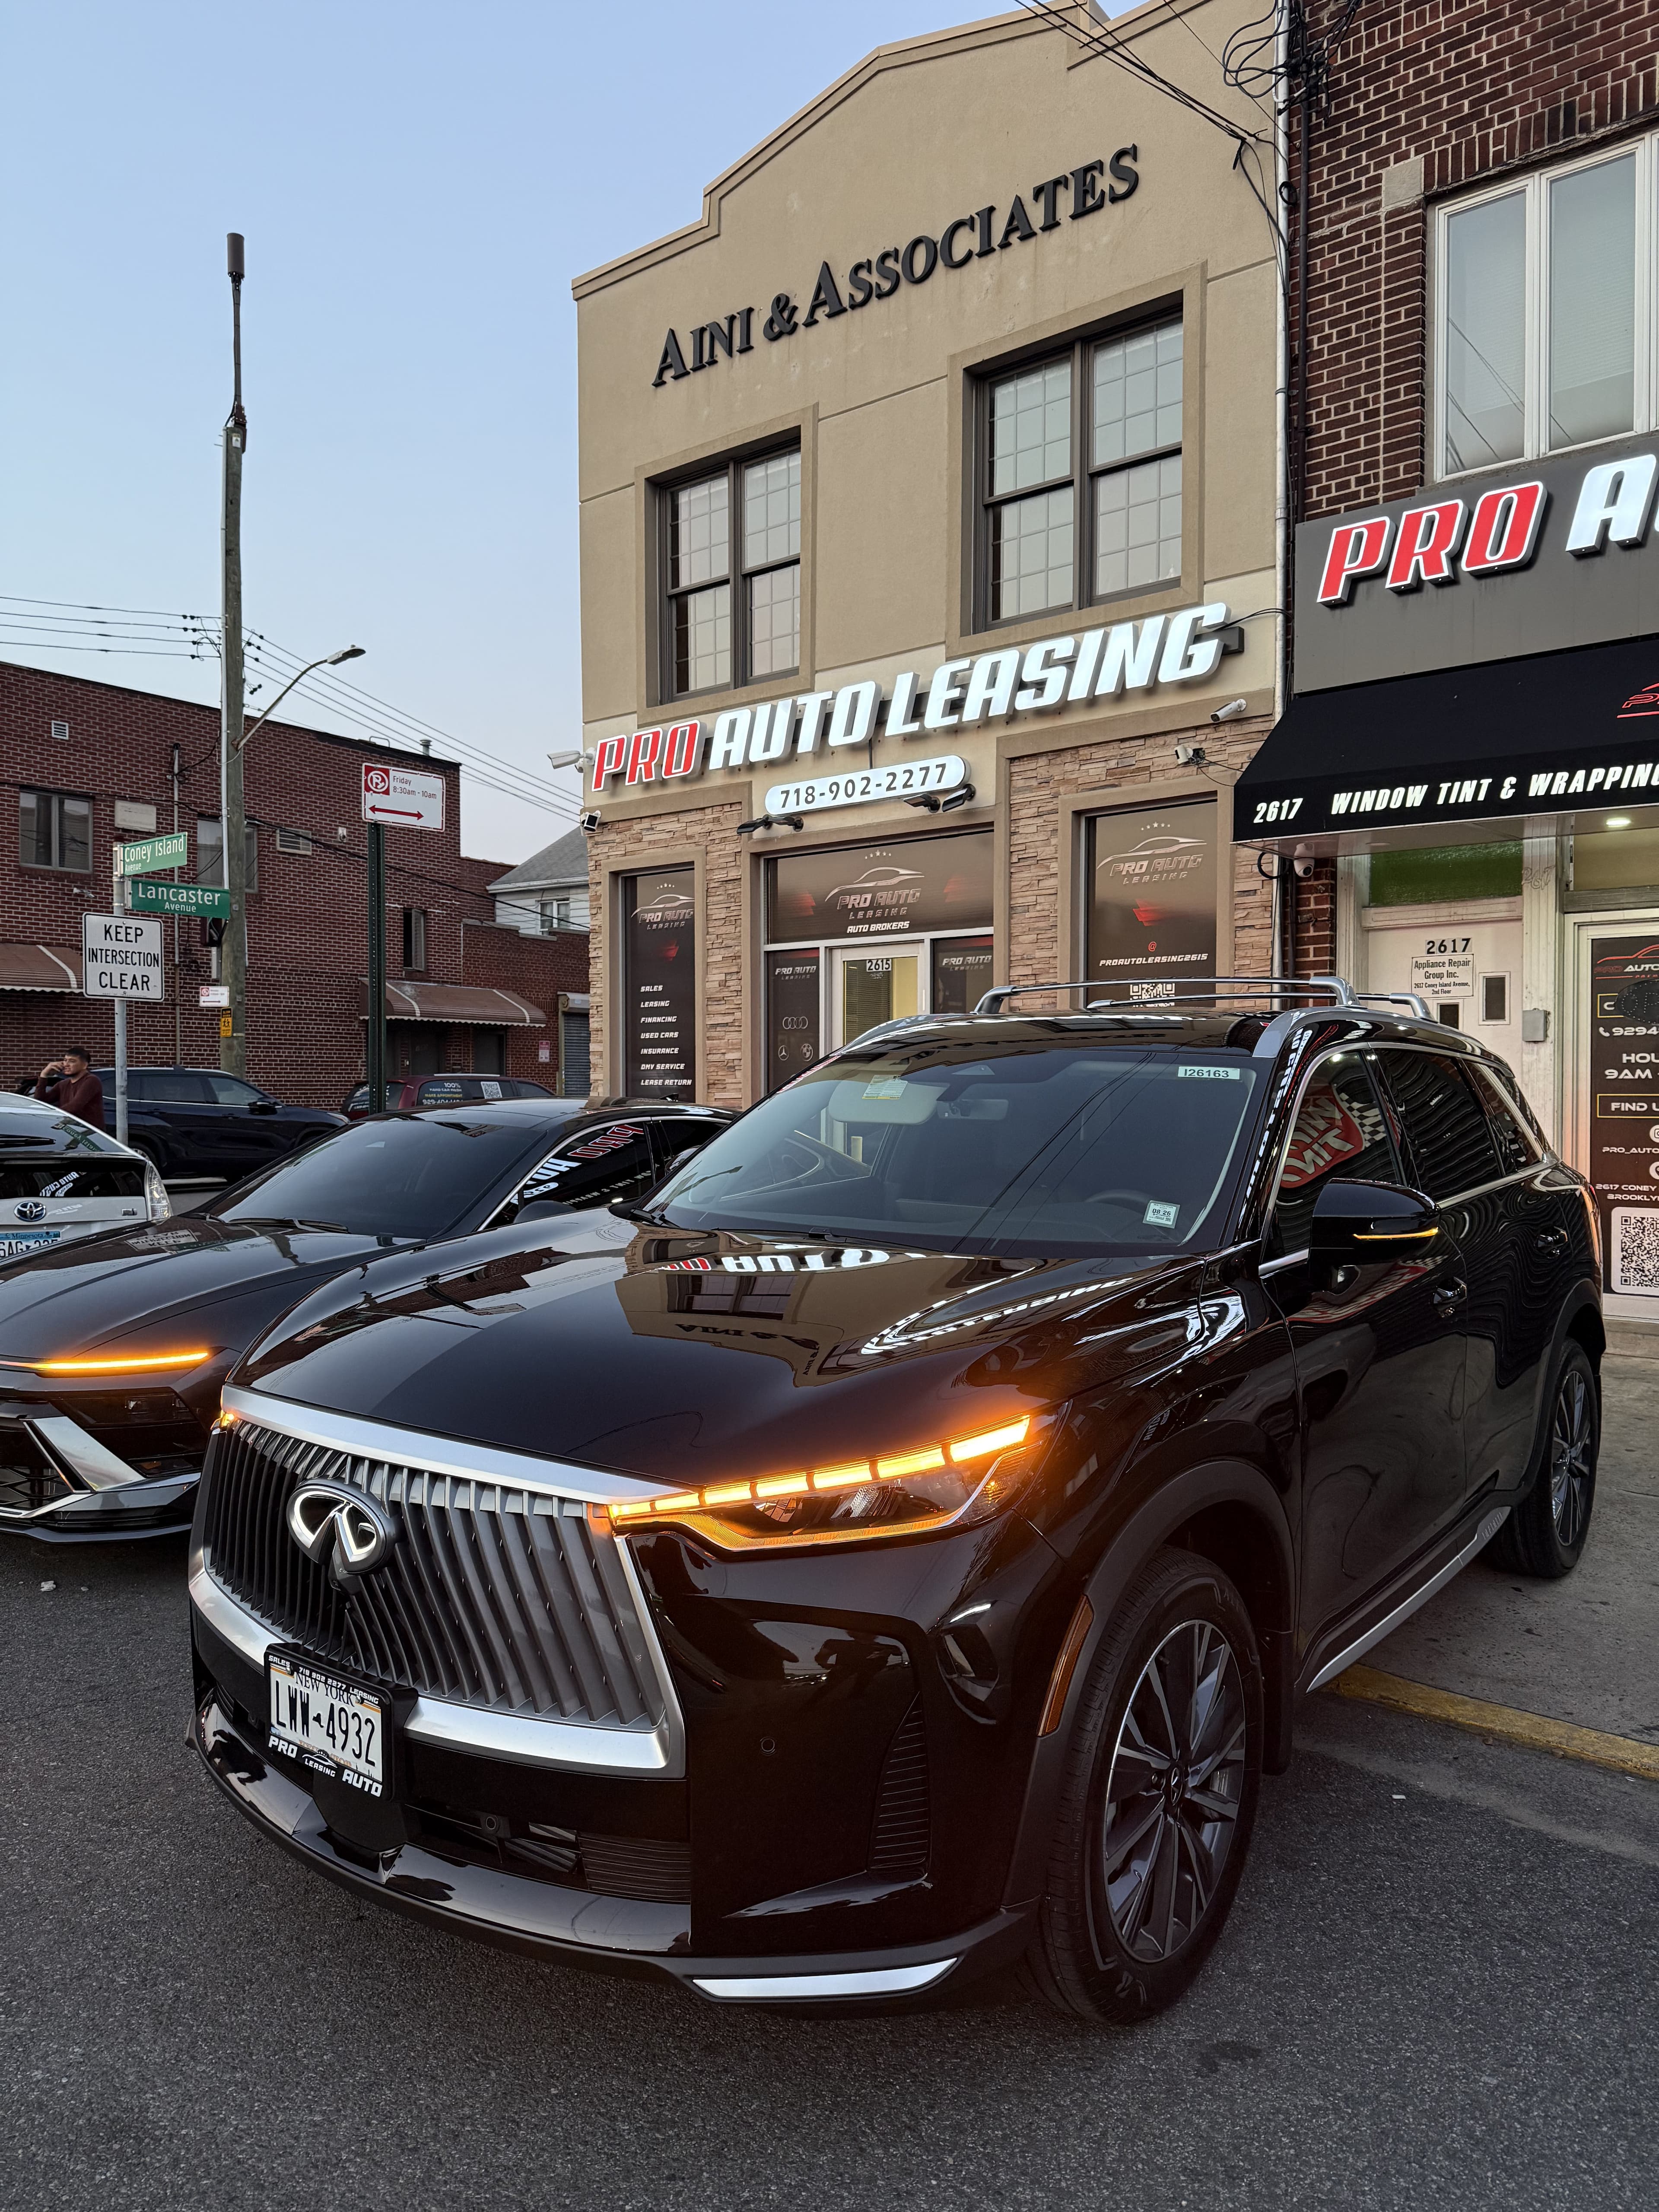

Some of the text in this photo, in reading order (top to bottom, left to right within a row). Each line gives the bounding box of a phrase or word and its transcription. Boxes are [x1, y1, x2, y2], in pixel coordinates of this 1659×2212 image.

[652, 143, 1139, 387] AINI & ASSOCIATES
[1316, 454, 1659, 605] PRO A
[591, 602, 1231, 791] PRO AUTO LEASING
[393, 775, 412, 786] Friday
[781, 763, 947, 808] 718-902-2277
[393, 786, 416, 796] 8:30am
[422, 790, 437, 799] 10am
[1253, 798, 1303, 823] 2617
[1331, 785, 1429, 815] WINDOW
[1436, 778, 1492, 805] TINT
[1500, 777, 1516, 799] &
[124, 836, 184, 863] Coney Island
[124, 862, 142, 872] Avenue
[1110, 854, 1205, 877] PRO AUTO
[1123, 872, 1188, 884] LEASING
[138, 883, 221, 906] Lancaster
[837, 889, 922, 910] PRO AUTO
[164, 902, 197, 912] Avenue
[849, 907, 908, 920] LEASING
[639, 909, 694, 923] PRO AUTO
[104, 924, 143, 944] KEEP
[847, 921, 910, 933] AUTO BROKERS
[1148, 941, 1157, 951] @
[1427, 938, 1471, 954] 2617
[88, 947, 159, 968] INTERSECTION
[942, 955, 992, 966] PRO AUTO
[1100, 953, 1208, 966] PROAUTOLEASING2615
[1414, 958, 1471, 970] Appliance Repair
[794, 966, 817, 974] AUTO
[867, 959, 890, 971] 2615
[99, 972, 150, 991] CLEAR
[1424, 970, 1459, 980] Group Inc.
[1612, 1027, 1659, 1036] 9294
[1605, 1069, 1653, 1079] 9AM
[1611, 1103, 1648, 1111] FIND
[268, 1655, 290, 1667] SALES
[311, 1673, 325, 1682] 902
[327, 1678, 346, 1690] 2277
[294, 1672, 355, 1707] NEW YORK
[349, 1687, 379, 1705] LEASING
[326, 1702, 375, 1767] 4932
[268, 1736, 298, 1758] PRO
[304, 1758, 336, 1777] LEASING
[342, 1769, 383, 1797] AUTO
